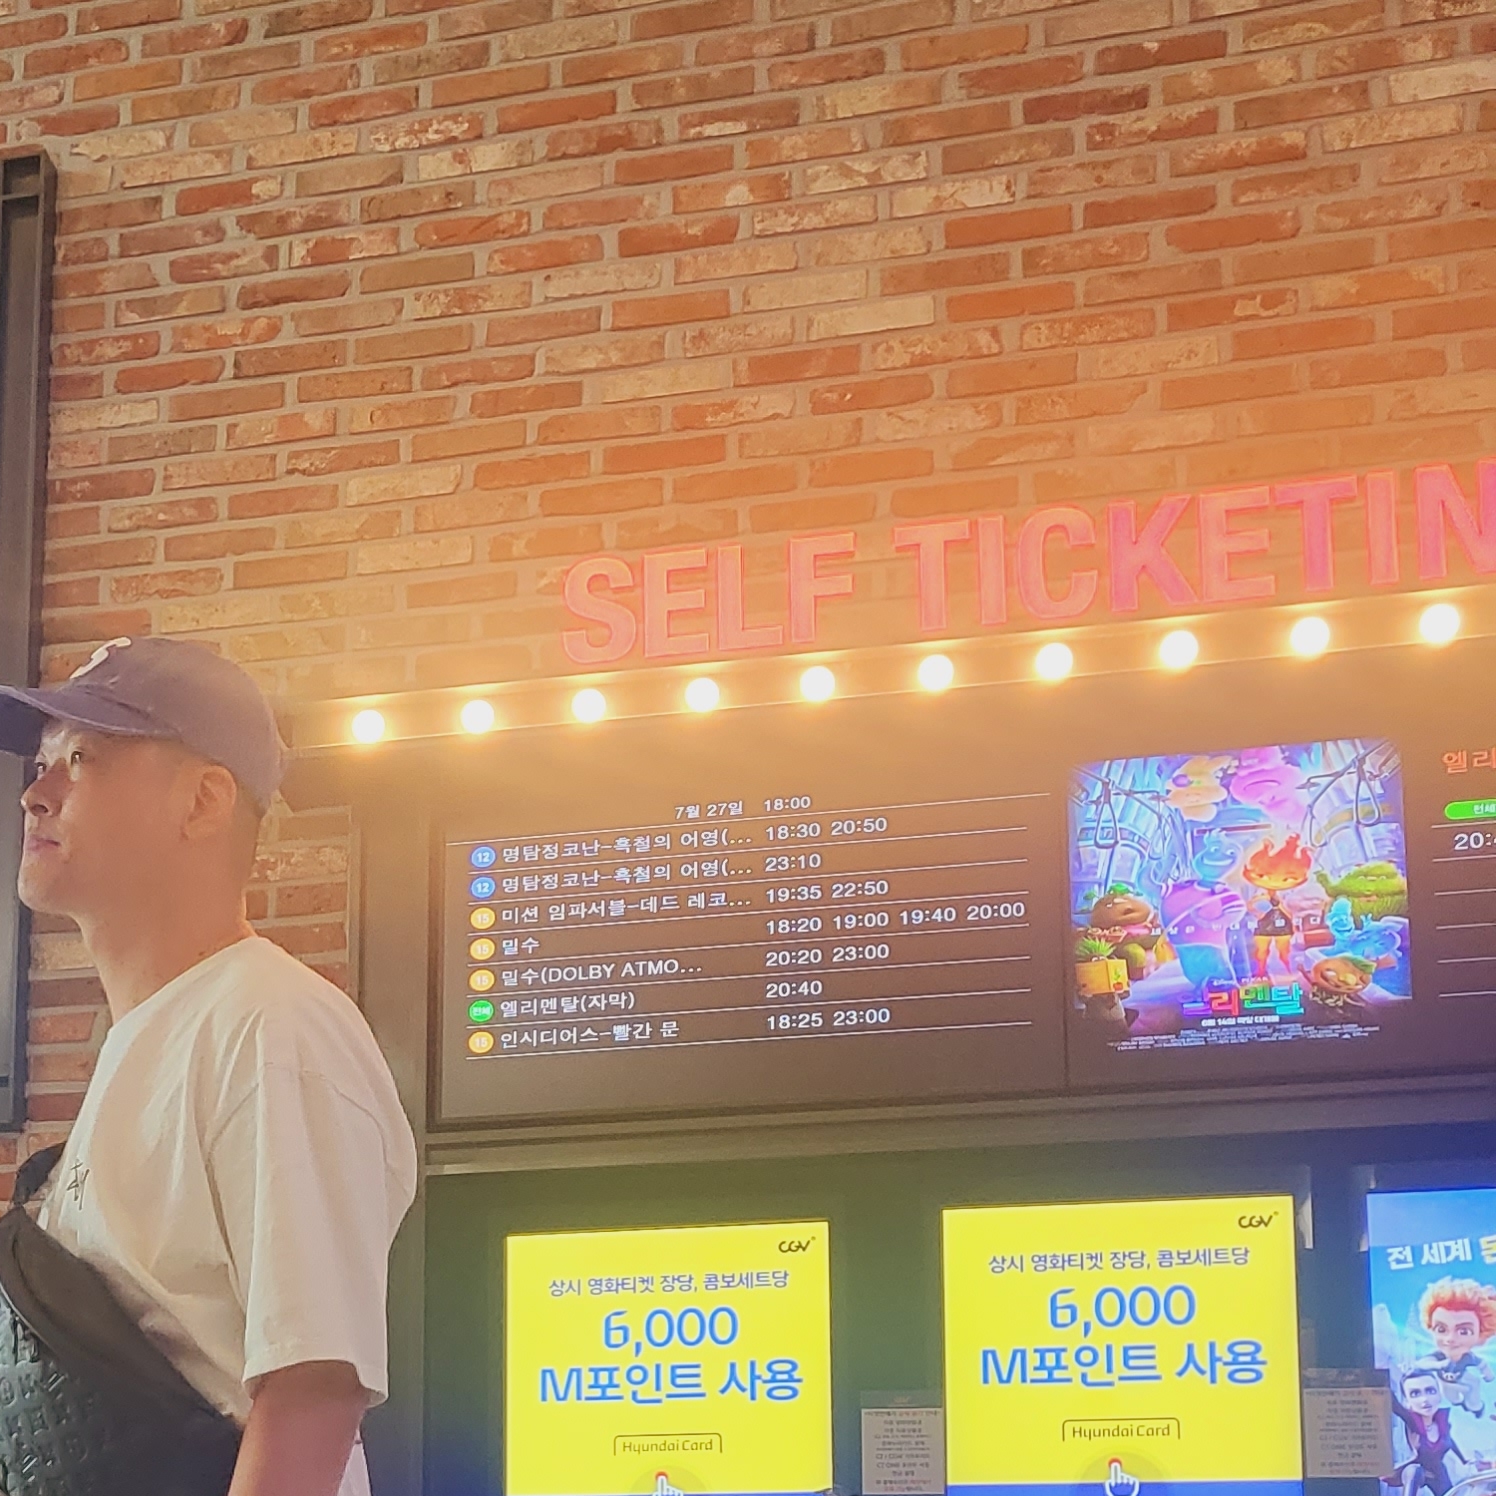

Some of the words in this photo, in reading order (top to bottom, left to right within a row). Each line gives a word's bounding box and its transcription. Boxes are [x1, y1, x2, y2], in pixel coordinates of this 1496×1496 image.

[561, 530, 858, 666] SELF
[892, 455, 1496, 634] TICKETIN
[675, 804, 700, 820] 7월
[706, 800, 744, 818] 27일
[764, 796, 811, 812] 18:00
[476, 851, 490, 863] 12
[502, 833, 672, 864] 명탐정코난-흑철의
[765, 823, 821, 841] 18:30
[830, 817, 888, 836] 20:50
[1454, 832, 1496, 851] 20:
[476, 882, 490, 894] 12
[502, 863, 672, 894] 명탐정코난-흑철의
[765, 853, 822, 872] 23:10
[501, 906, 539, 925] 미션
[548, 894, 680, 921] 임파서블-데드
[765, 885, 822, 903] 19:35
[831, 880, 889, 899] 22:50
[501, 937, 540, 956] 밀수
[766, 916, 822, 935] 18:20
[833, 912, 889, 930] 19:00
[899, 906, 956, 925] 19:40
[966, 902, 1025, 921] 20:00
[501, 963, 615, 987] 밀수(DOLBY
[765, 948, 823, 967] 20:20
[832, 943, 890, 962] 23:00
[500, 990, 636, 1018] 엘리멘탈(자막)
[765, 980, 823, 998] 20:40
[500, 1023, 653, 1050] 인시디어스-빨간
[659, 1021, 680, 1038] 문
[767, 1013, 823, 1030] 18:25
[833, 1008, 890, 1026] 23:00
[1238, 1214, 1273, 1229] CGV
[778, 1238, 811, 1254] CGV
[988, 1254, 1024, 1274] 상시
[1030, 1252, 1104, 1272] 영화티켓
[1109, 1250, 1151, 1270] 장당,
[1156, 1246, 1250, 1268] 콤보세트당
[1386, 1246, 1414, 1270] 전
[1421, 1237, 1472, 1265] 세계
[549, 1278, 581, 1297] 상시
[587, 1275, 655, 1296] 영화티켓
[659, 1274, 698, 1293] 장당,
[703, 1270, 790, 1291] 콤보세트당
[603, 1306, 739, 1358] 6,000
[1049, 1284, 1196, 1339] 6,000
[540, 1363, 707, 1404] M포인트
[717, 1359, 804, 1402] 사용
[981, 1343, 1163, 1388] M포인트
[1175, 1339, 1268, 1384] 사용
[622, 1439, 680, 1455] Hyundai
[681, 1438, 713, 1452] Card
[1071, 1424, 1134, 1441] Hyundai
[1136, 1424, 1171, 1439] Card
